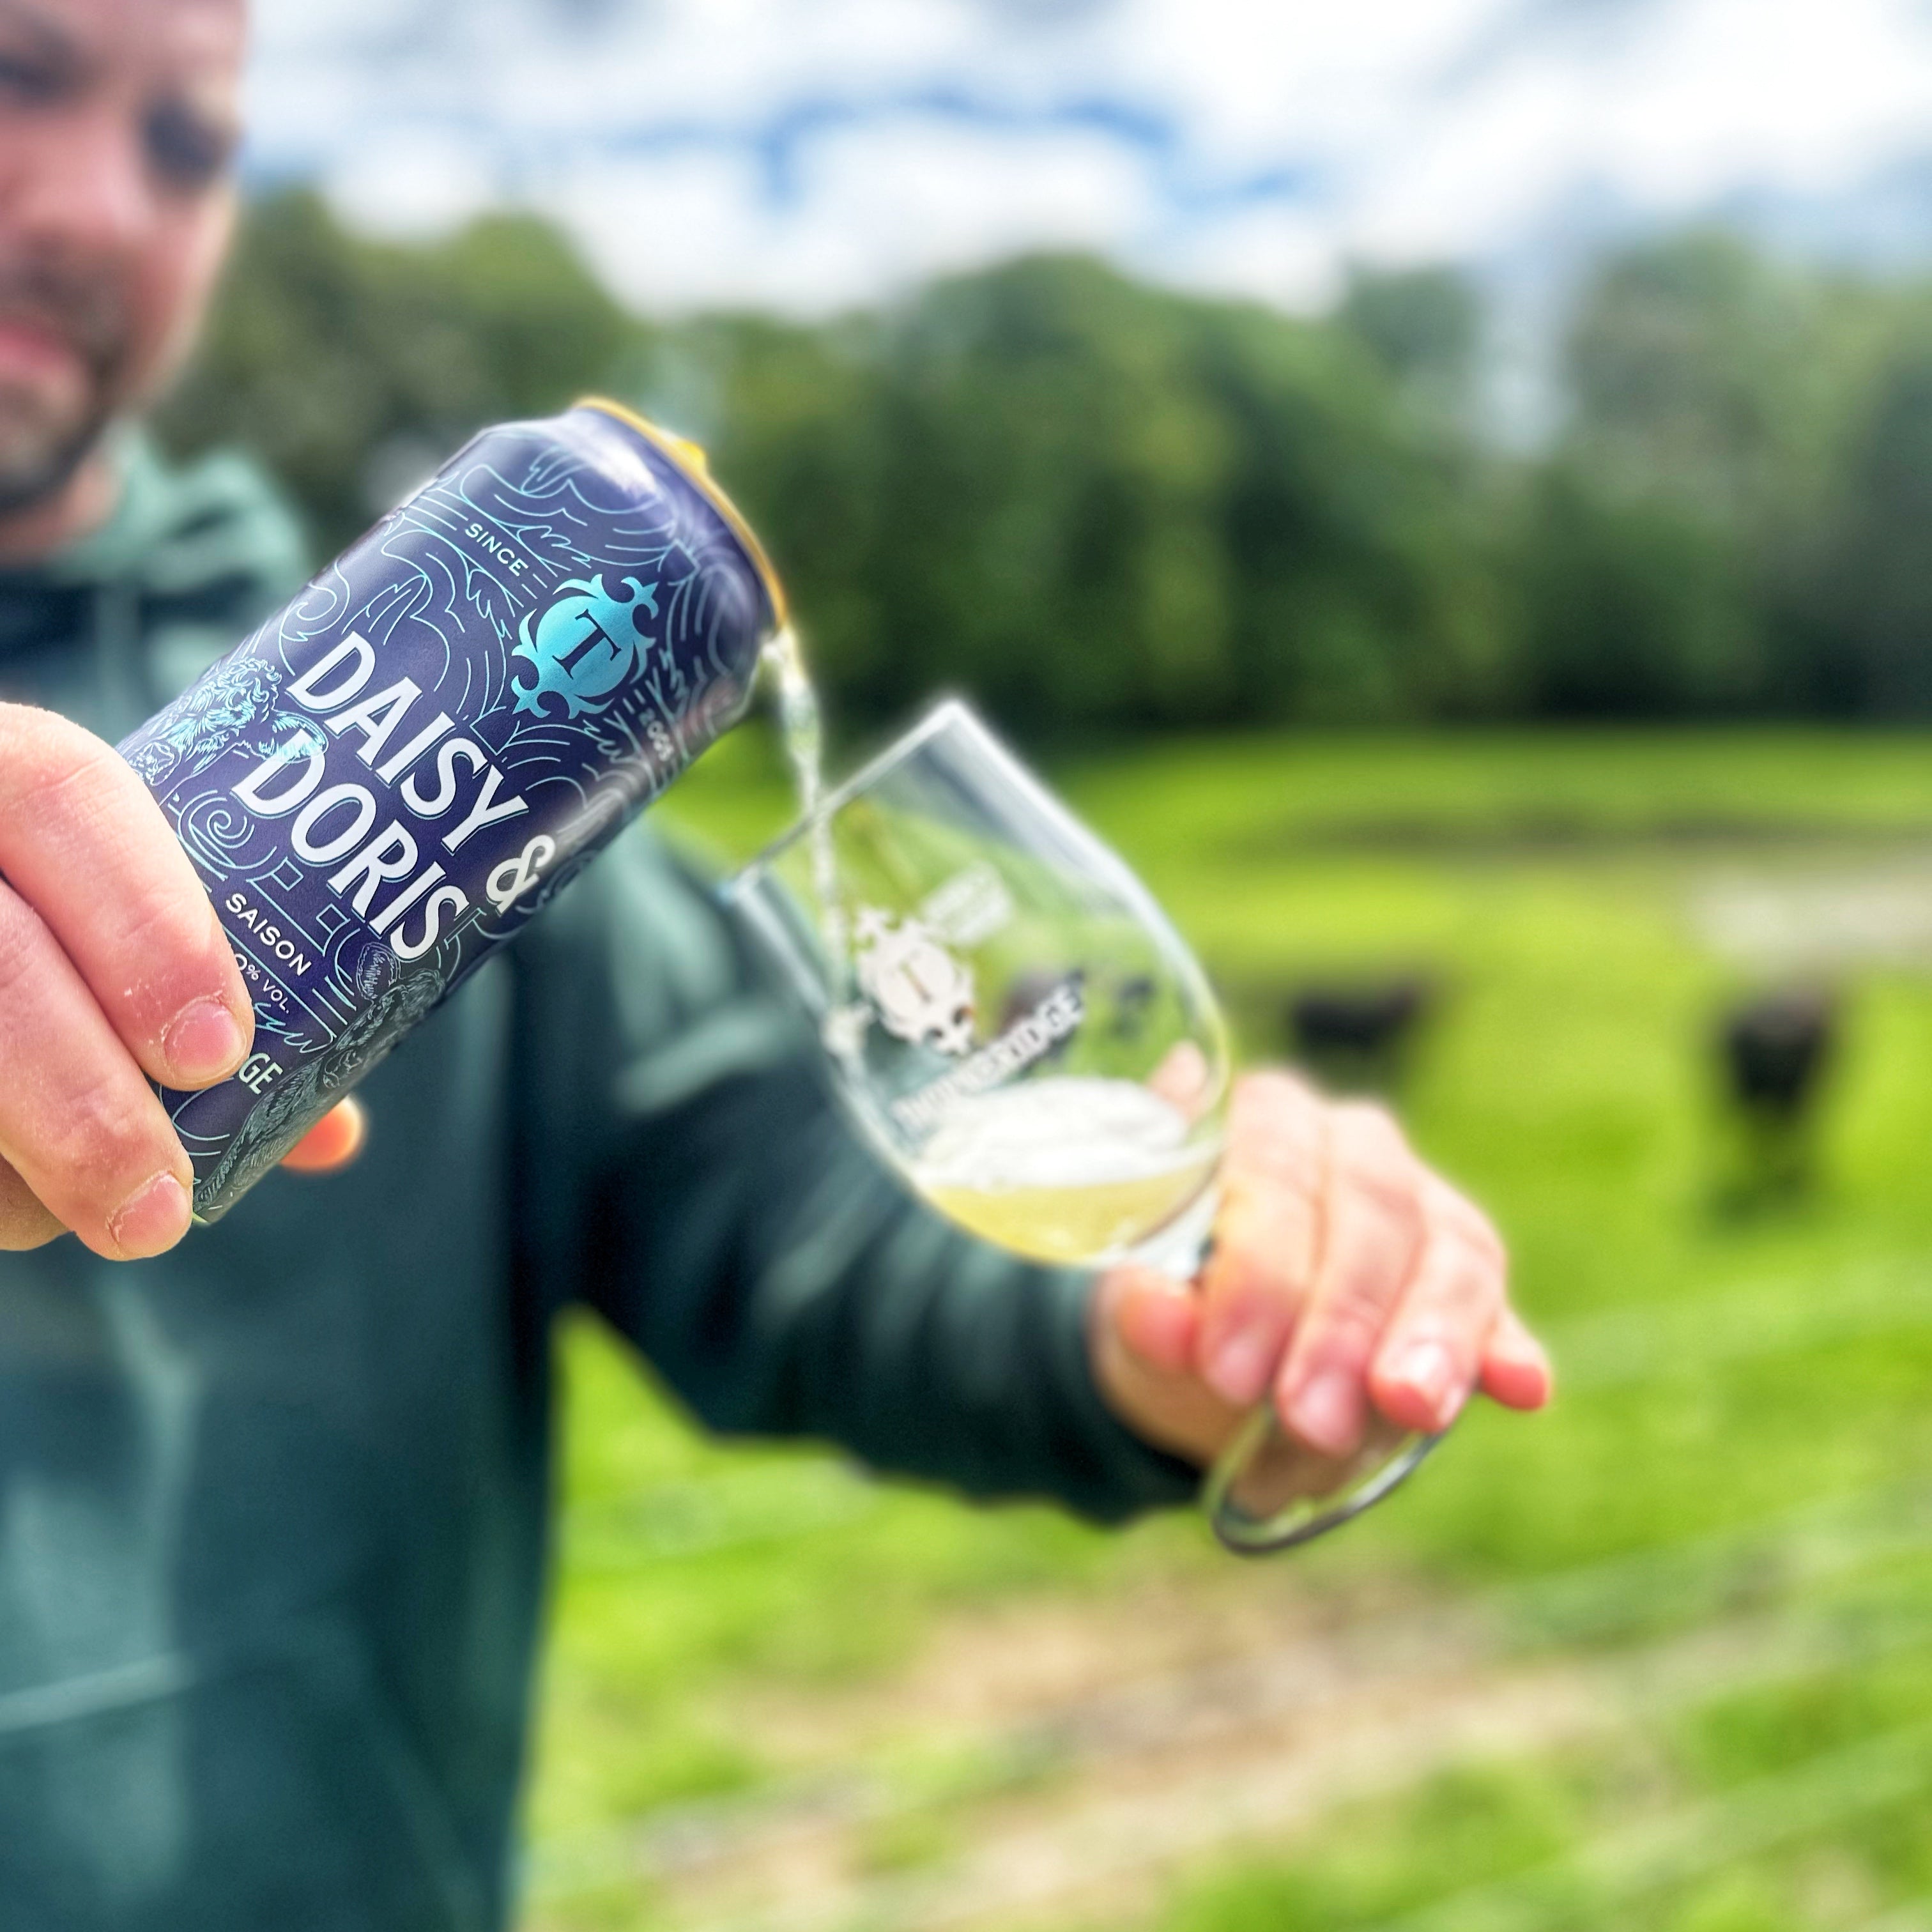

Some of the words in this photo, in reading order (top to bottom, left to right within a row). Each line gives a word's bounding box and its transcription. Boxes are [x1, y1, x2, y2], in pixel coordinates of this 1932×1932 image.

[465, 523, 529, 576] SINCE
[551, 608, 622, 680] T
[286, 631, 530, 854] DAISY
[486, 834, 555, 916] &
[230, 729, 470, 960] DORIS
[226, 893, 312, 976] SAISON
[263, 978, 289, 1014] VOL.
